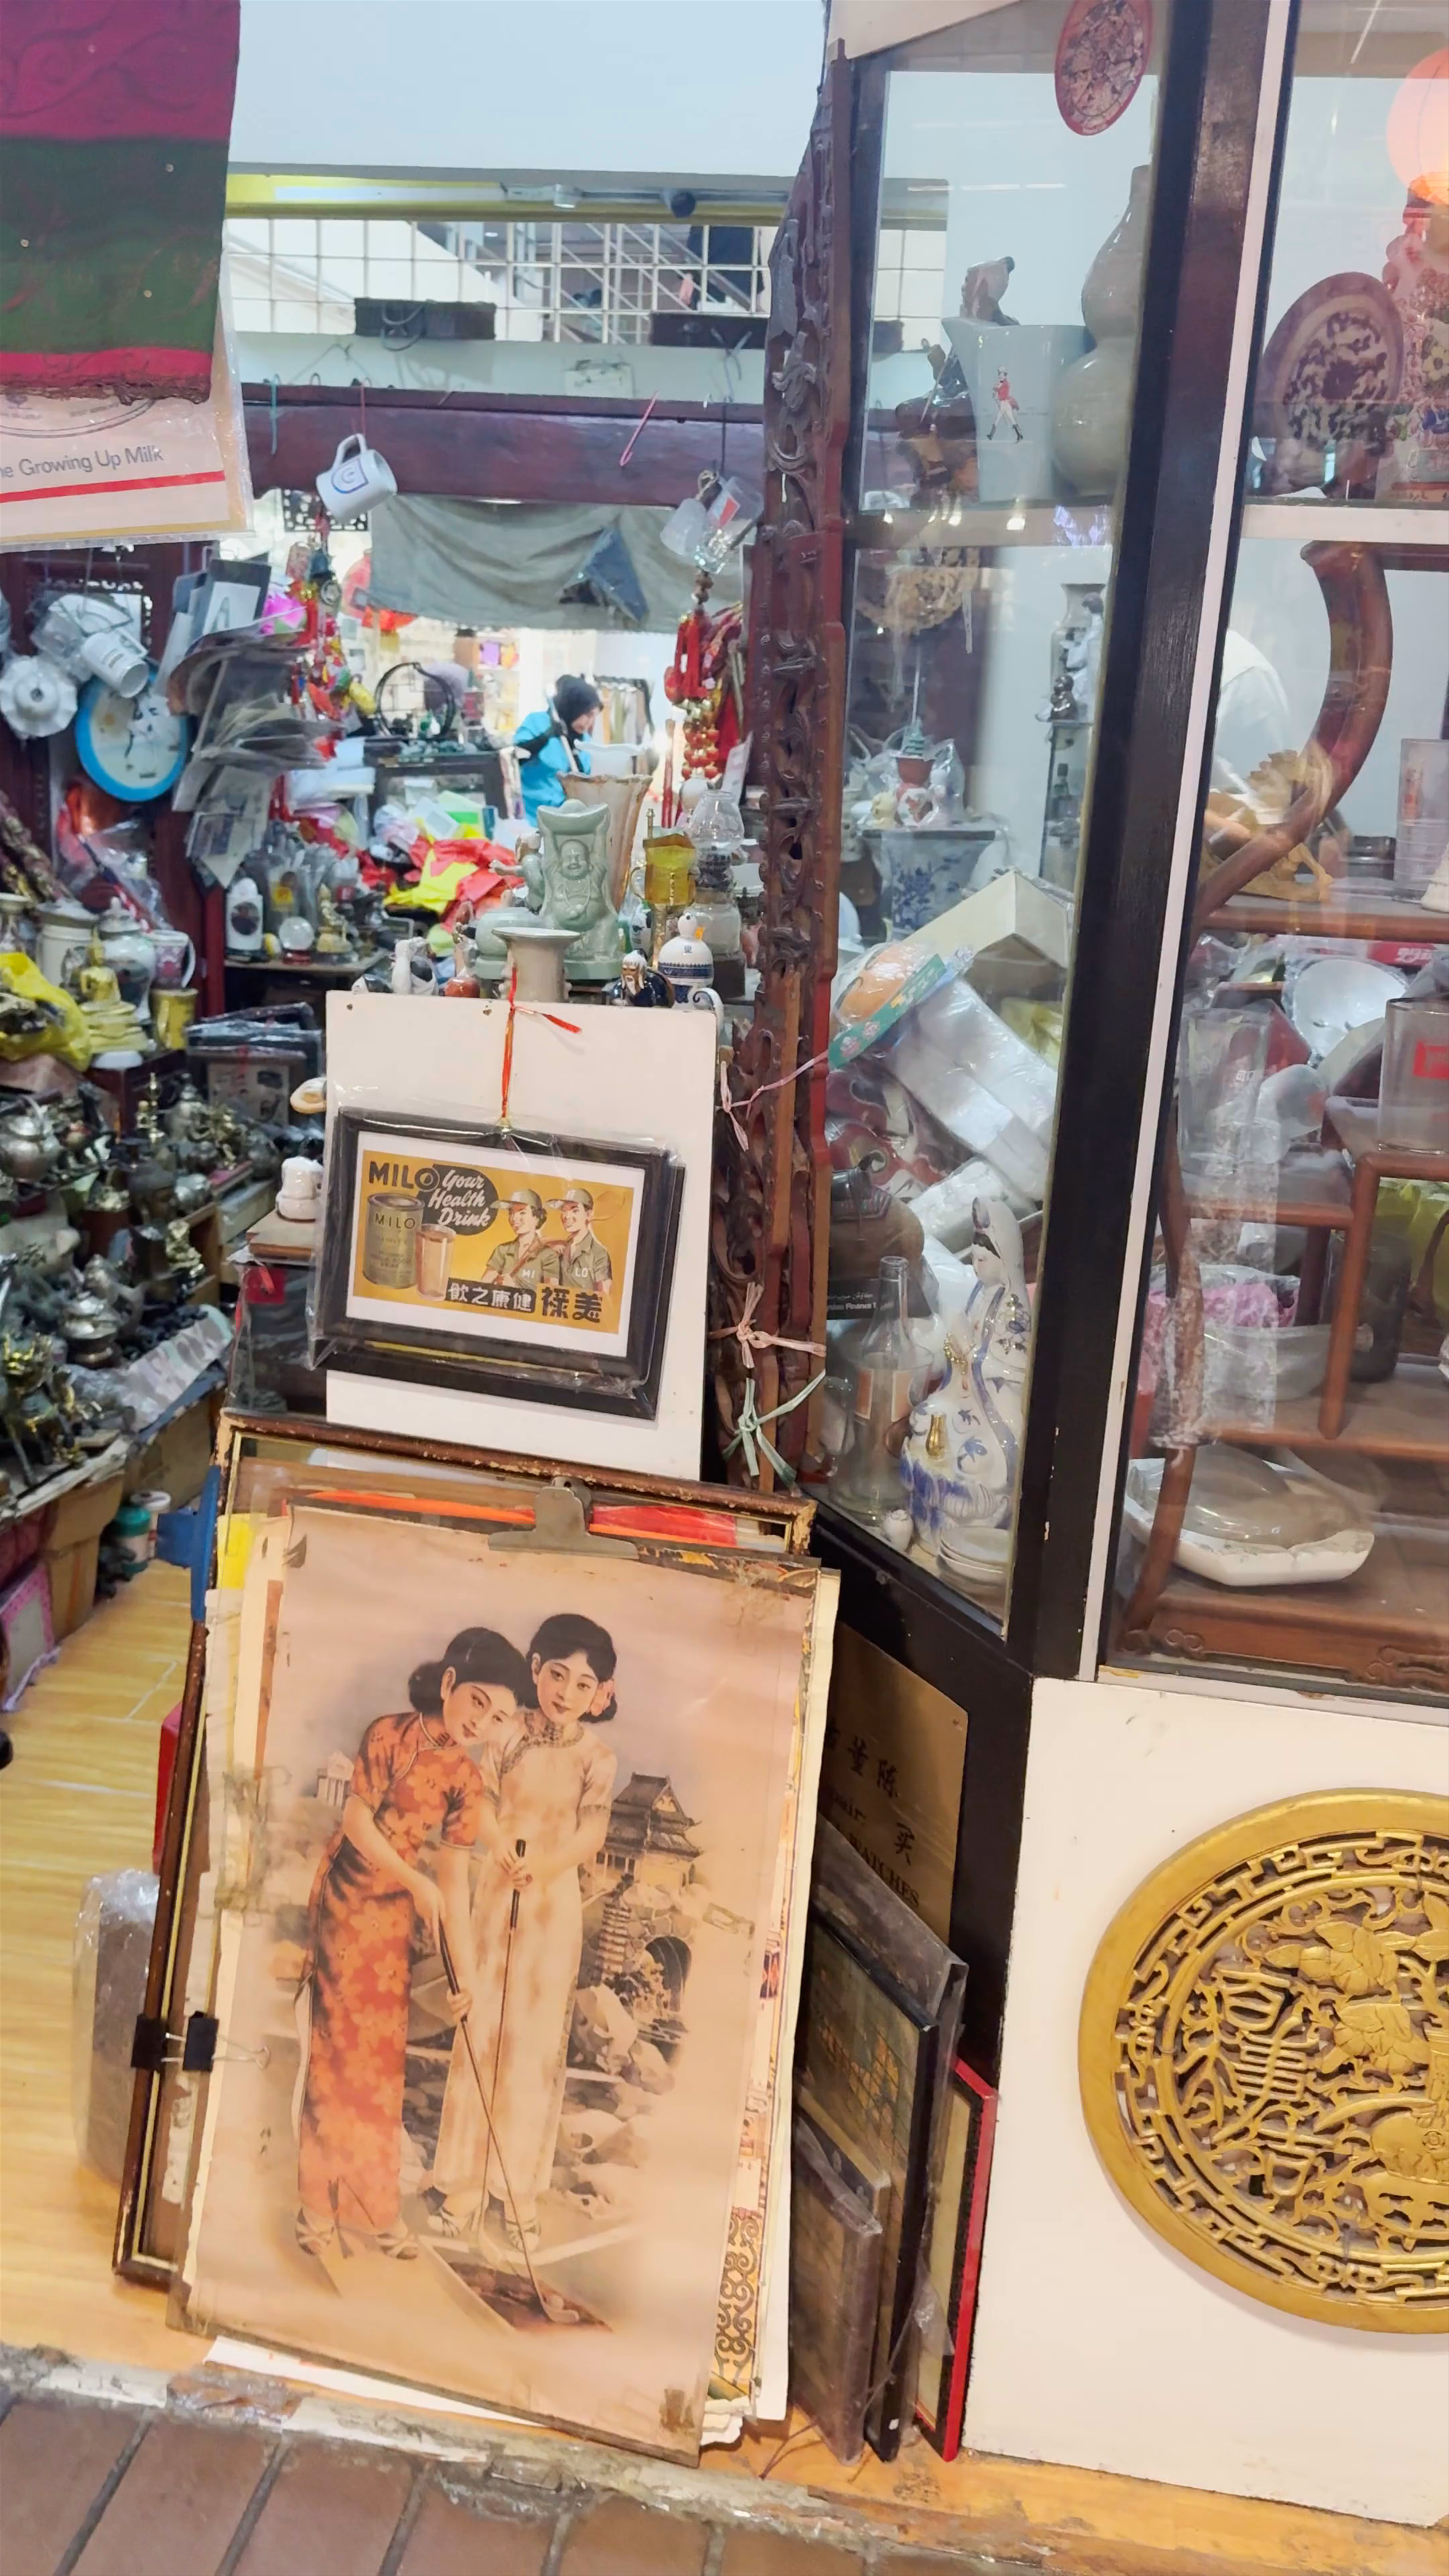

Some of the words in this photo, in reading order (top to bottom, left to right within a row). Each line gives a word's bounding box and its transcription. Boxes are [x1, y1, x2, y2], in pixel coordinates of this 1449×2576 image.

[18, 455, 93, 476] Growing
[94, 450, 121, 470] Up
[125, 445, 164, 464] Milk
[369, 1161, 440, 1192] MILO
[442, 1170, 485, 1191] Your
[428, 1188, 486, 1209] Health
[375, 1213, 415, 1229] MILO
[437, 1207, 491, 1227] Drink
[522, 1269, 535, 1278] MI
[575, 1267, 588, 1278] LO
